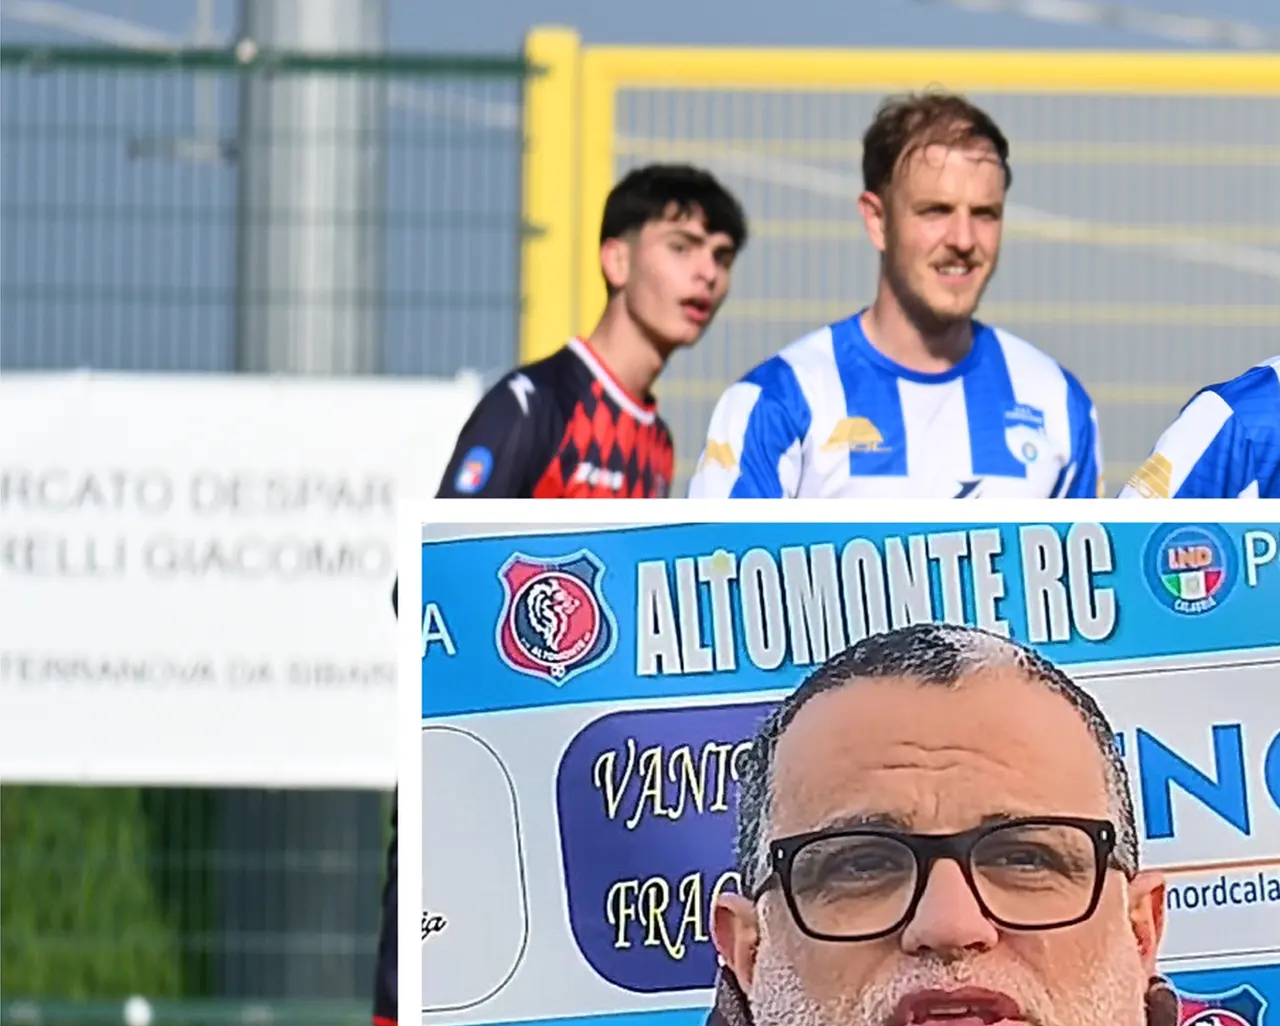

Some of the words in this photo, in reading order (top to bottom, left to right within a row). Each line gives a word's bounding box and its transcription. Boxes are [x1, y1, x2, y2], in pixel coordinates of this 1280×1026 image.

[636, 529, 1010, 678] ALTOMONTE
[1017, 521, 1119, 645] RC
[1167, 545, 1213, 571] LND
